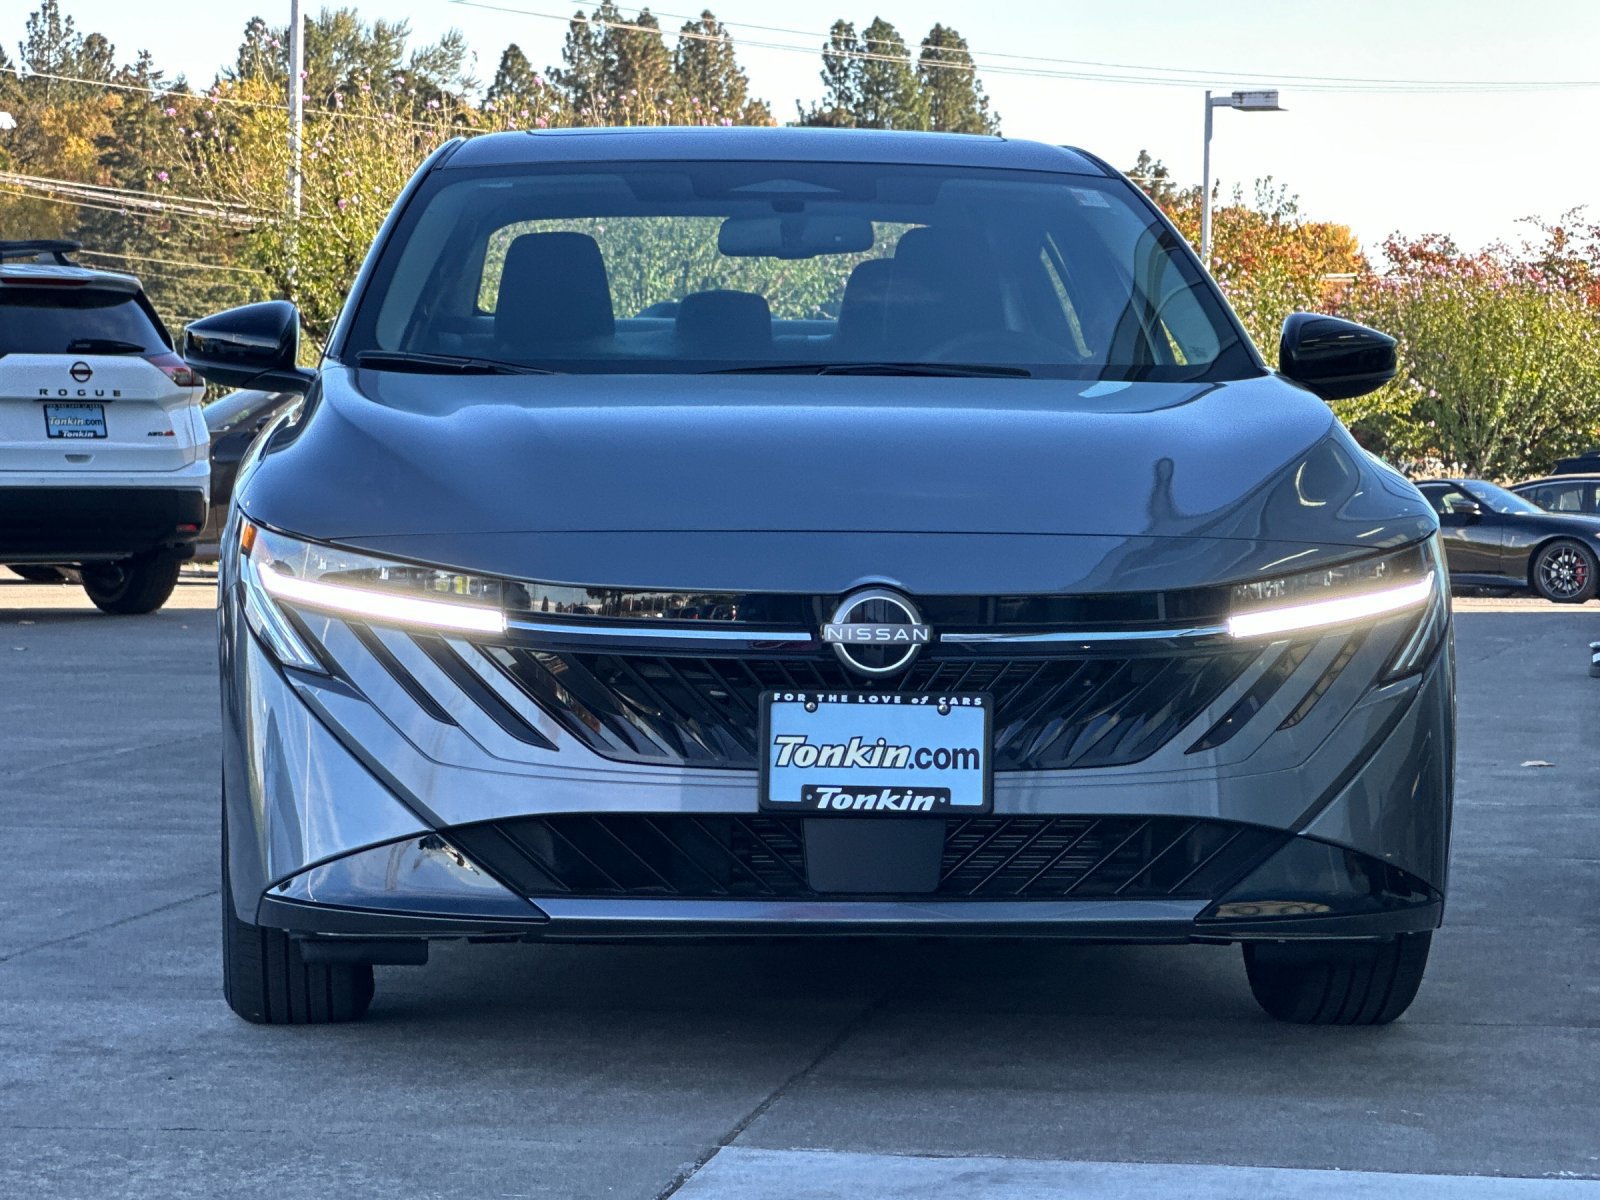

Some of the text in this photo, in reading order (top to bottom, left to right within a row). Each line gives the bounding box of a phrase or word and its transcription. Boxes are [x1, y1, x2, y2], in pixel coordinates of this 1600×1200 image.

[39, 388, 121, 397] ROGUE
[49, 416, 103, 427] Tonkin.com
[62, 430, 95, 438] Tonkin
[827, 627, 929, 641] NISSAN
[773, 692, 806, 702] FOR
[817, 694, 848, 703] THE
[858, 695, 902, 704] LOVE
[938, 696, 982, 706] CARS
[774, 734, 980, 770] Tonkin.com
[815, 787, 935, 812] Tonkin
